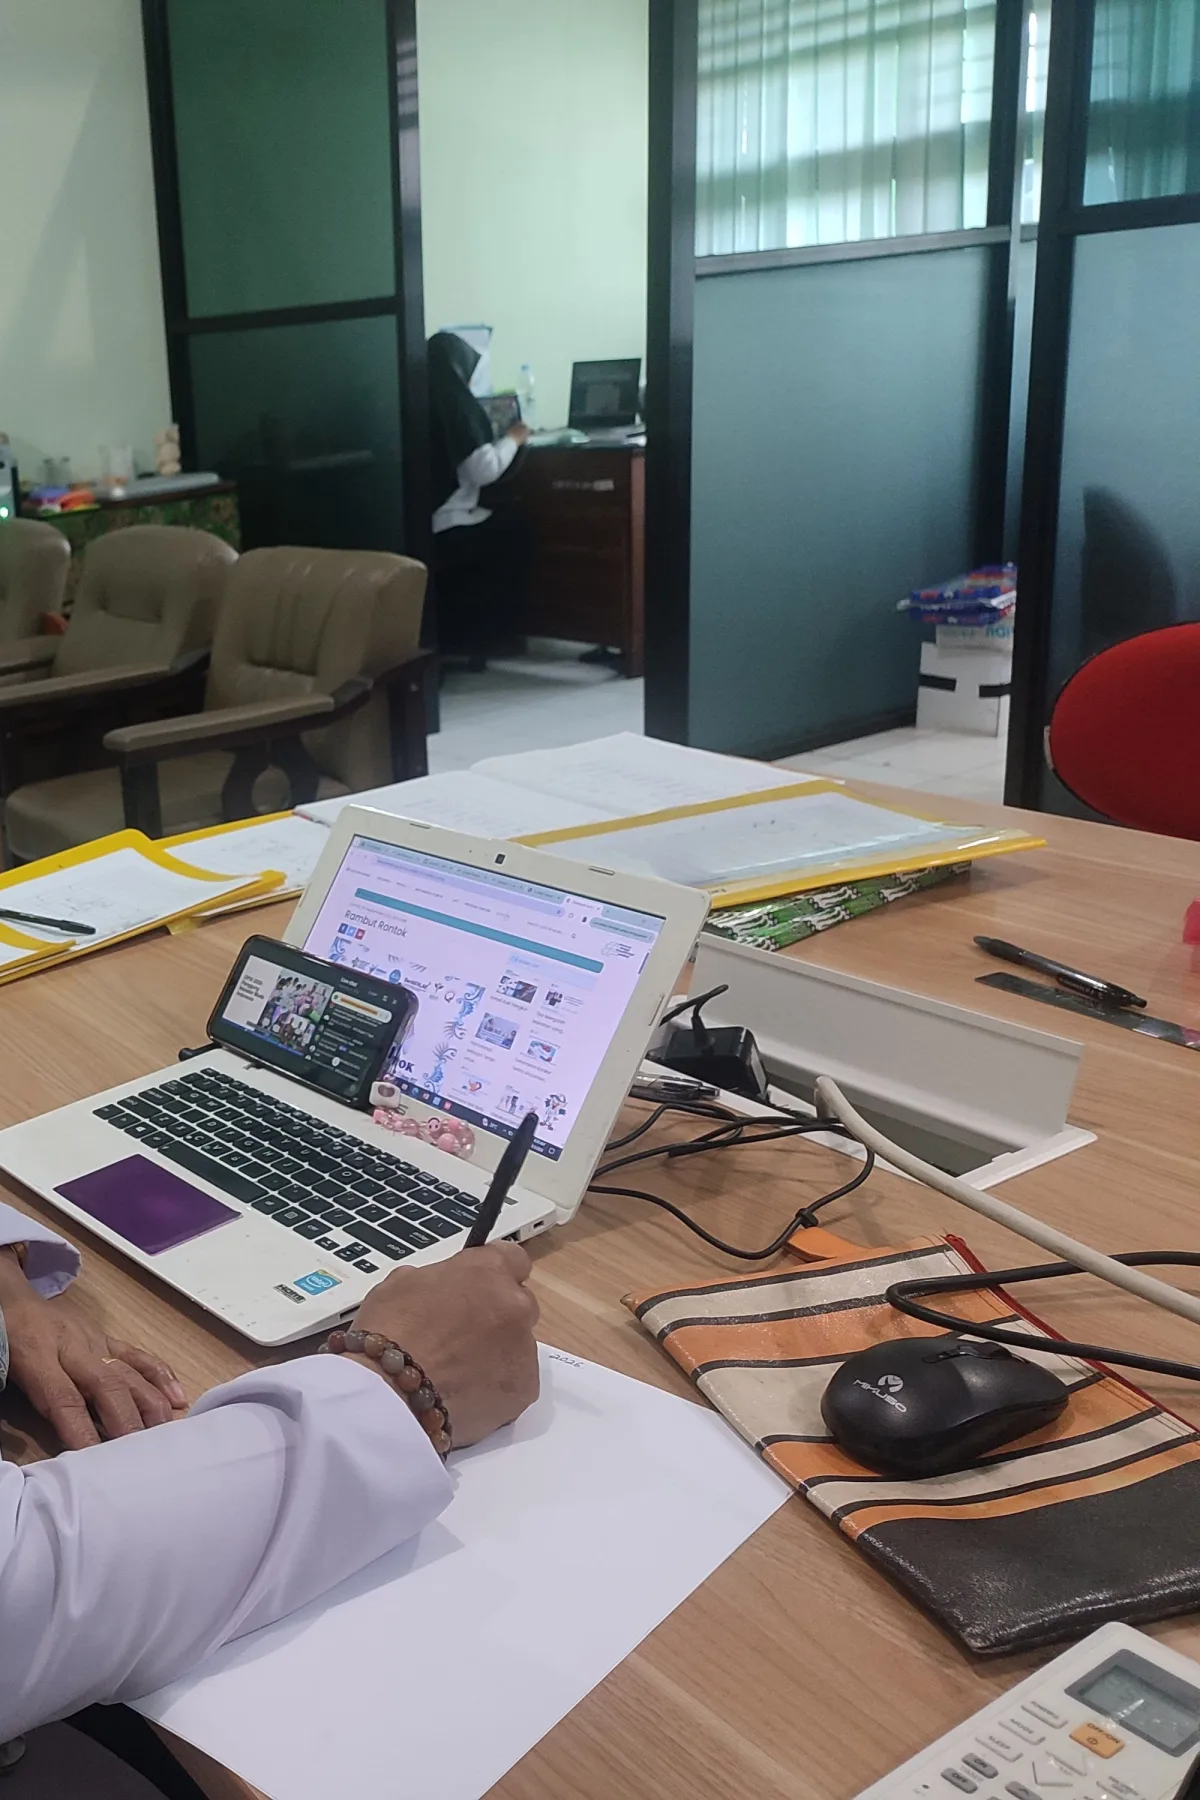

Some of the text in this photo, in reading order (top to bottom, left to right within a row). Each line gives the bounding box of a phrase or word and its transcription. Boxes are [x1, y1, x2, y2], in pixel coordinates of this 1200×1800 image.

[344, 909, 378, 929] Rambut
[378, 920, 408, 938] Rontok
[549, 1354, 585, 1369] 2026
[852, 1379, 907, 1413] MIKUSO
[1010, 1718, 1034, 1734] MODE
[989, 1735, 1011, 1750] SLEEP
[974, 1758, 988, 1769] ON
[952, 1772, 967, 1783] OFF
